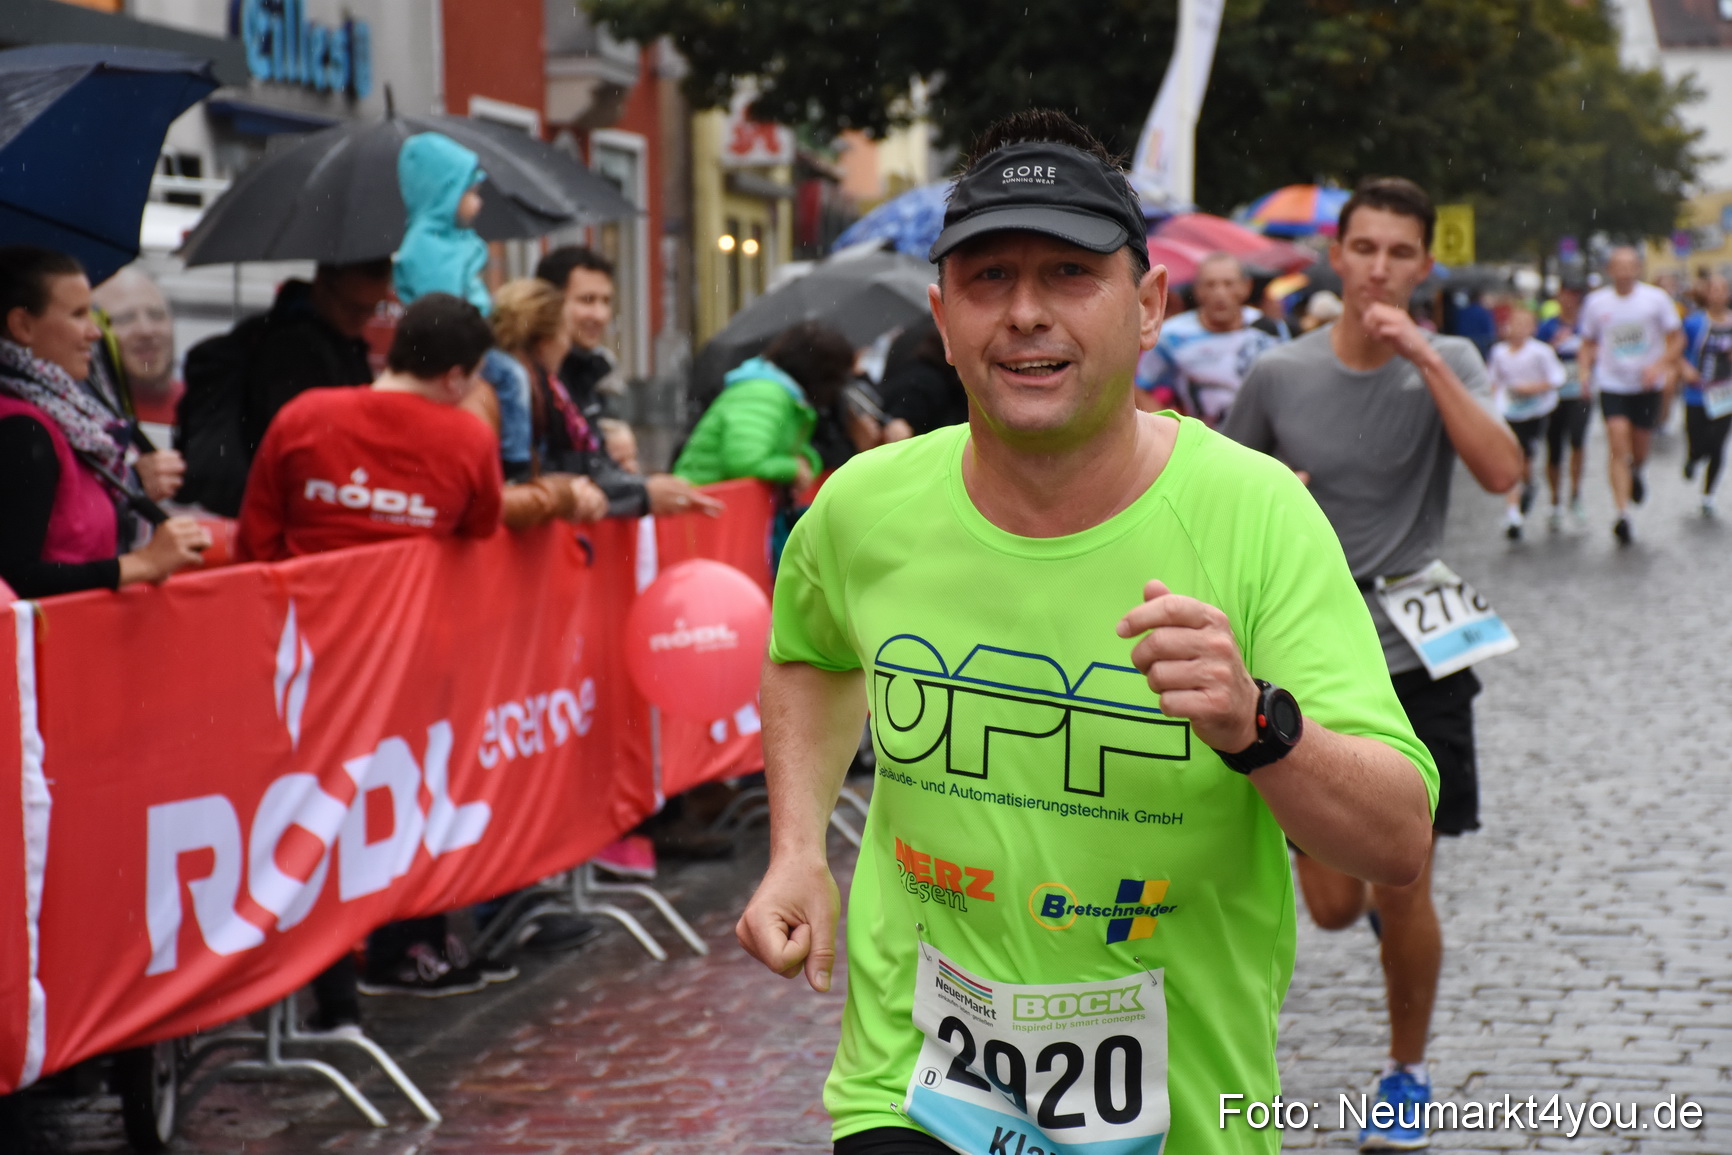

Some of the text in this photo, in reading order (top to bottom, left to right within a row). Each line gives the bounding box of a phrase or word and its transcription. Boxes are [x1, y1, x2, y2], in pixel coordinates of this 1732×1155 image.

[1002, 165, 1057, 178] GORE
[1002, 177, 1034, 185] RUNNING
[920, 779, 946, 795] und
[949, 782, 1130, 822] Automatisierungstechnik
[1134, 810, 1184, 825] GmbH
[1040, 893, 1178, 919] Bretschneider
[935, 976, 997, 1021] NeuerMarkt
[1013, 984, 1145, 1021] BOCK
[1012, 1012, 1146, 1033] inspired by smart concepts
[923, 1069, 937, 1087] D
[937, 1015, 1143, 1131] 2920
